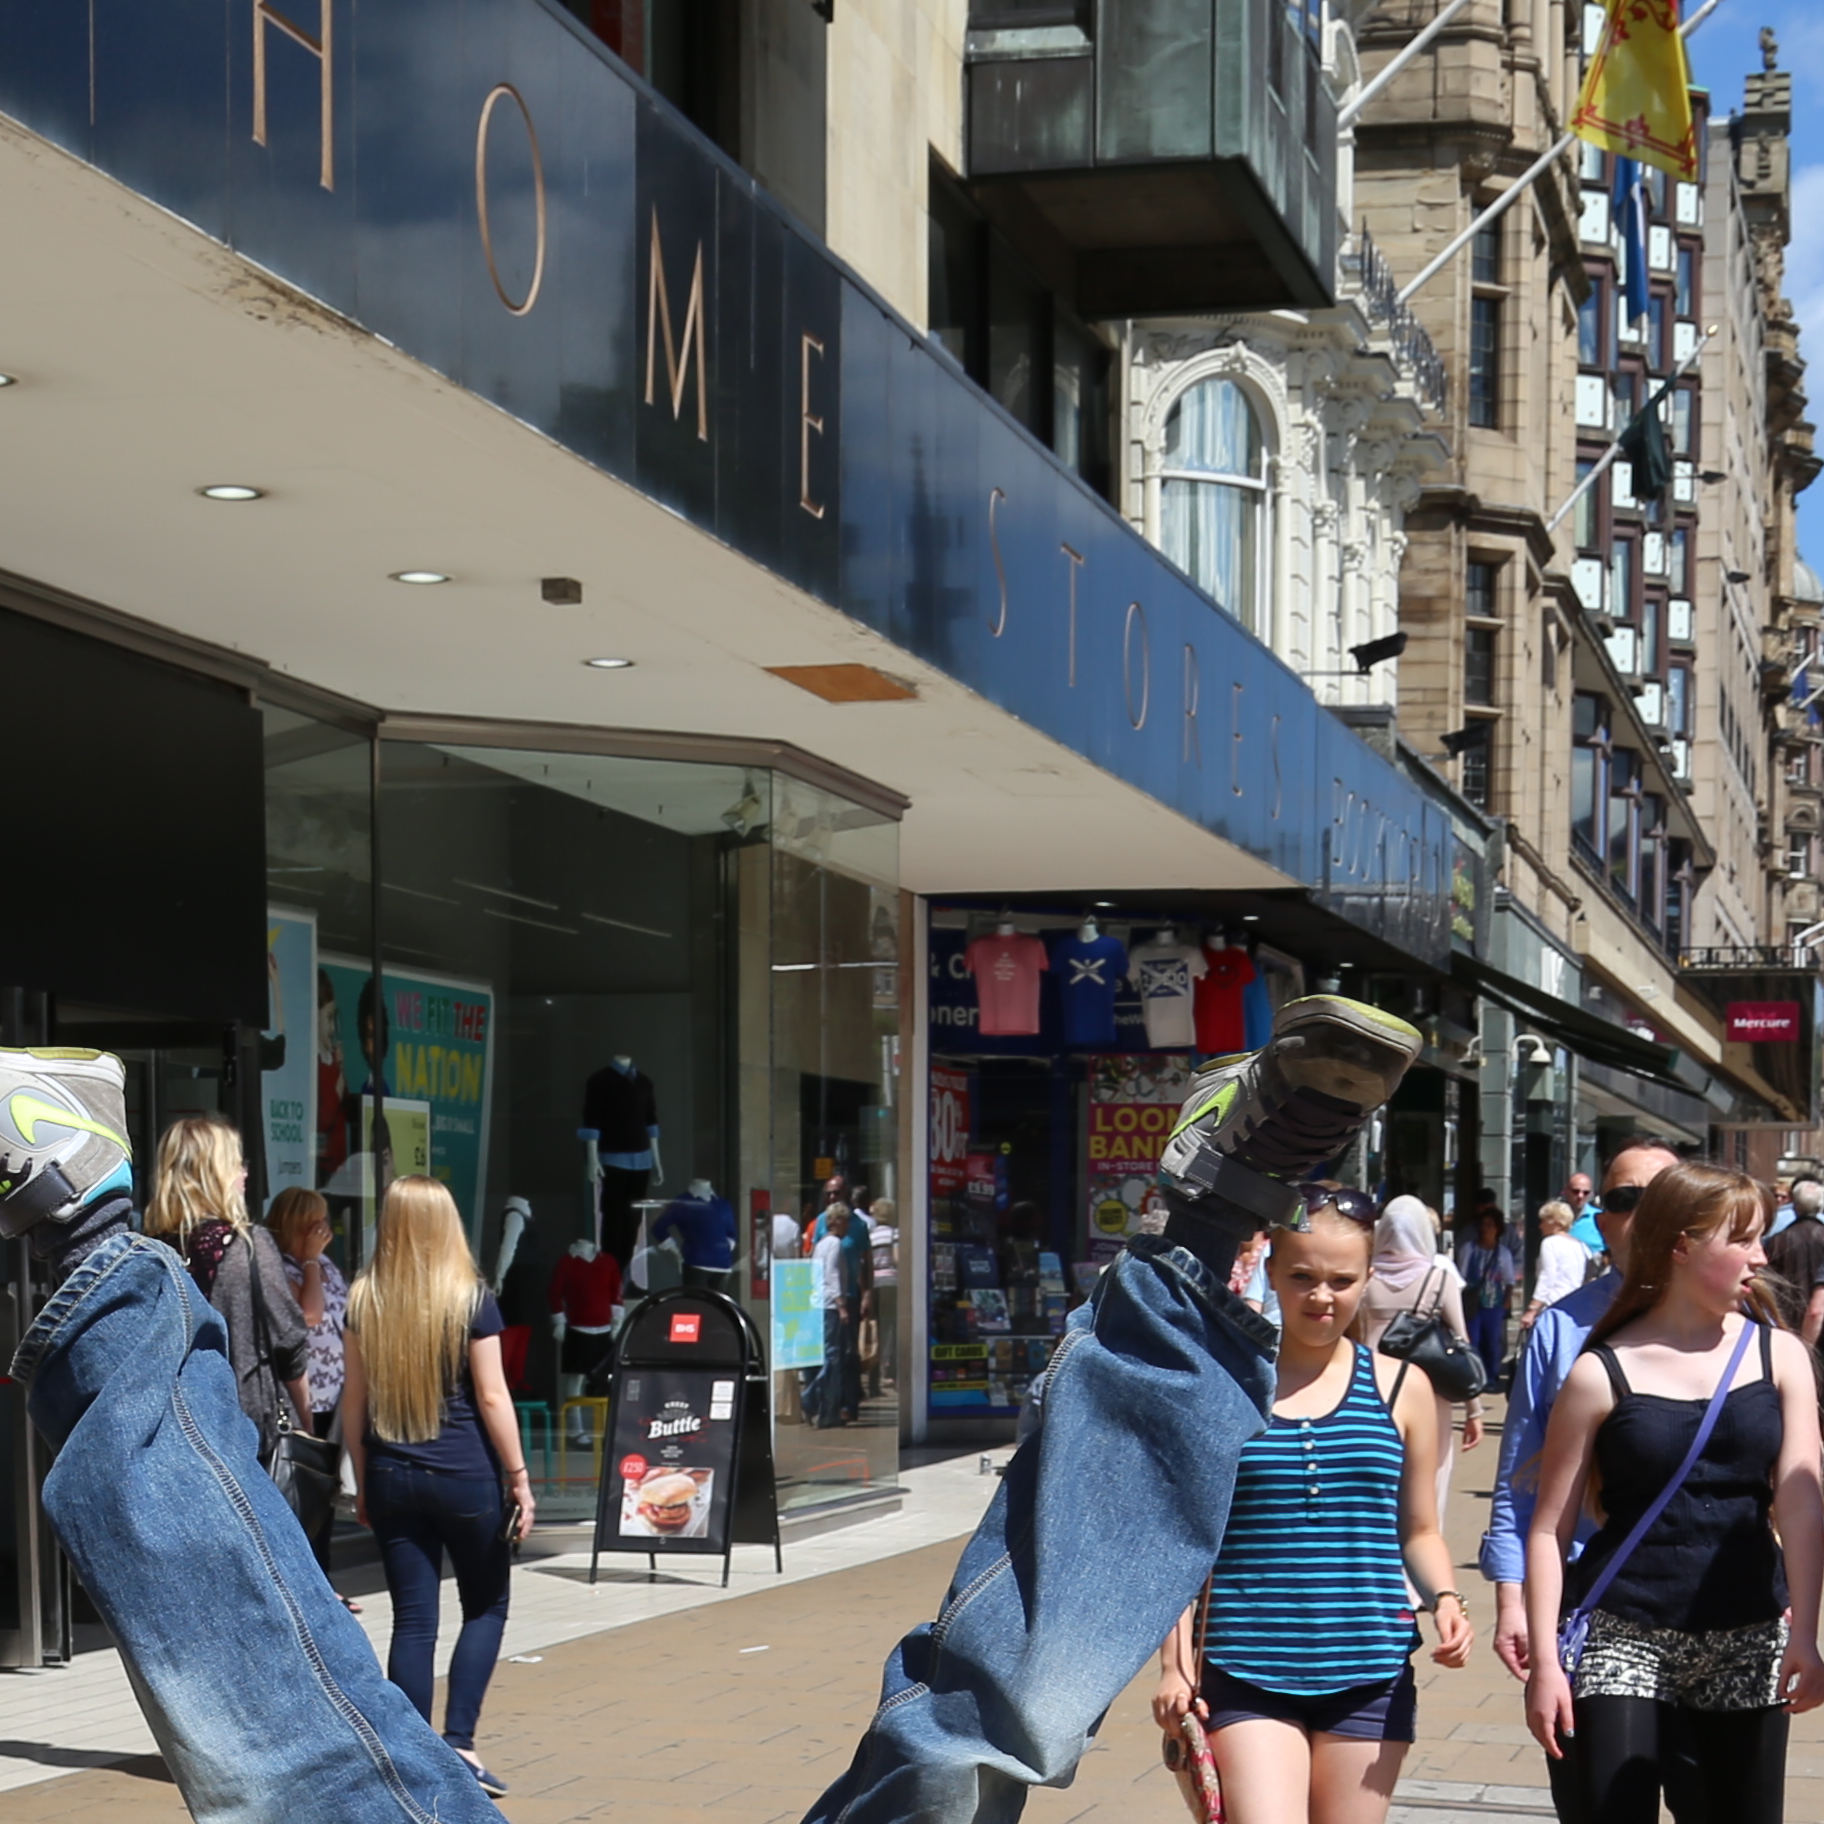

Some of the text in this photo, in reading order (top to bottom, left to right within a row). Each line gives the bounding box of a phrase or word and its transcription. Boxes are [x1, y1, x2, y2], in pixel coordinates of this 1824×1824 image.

[252, 0, 1283, 820] HOME STORES
[395, 991, 485, 1041] WE FIT THE
[1733, 1017, 1791, 1028] Mercure
[395, 1041, 483, 1105] NATION
[270, 1122, 305, 1143] SCHOOL
[674, 1322, 695, 1334] BHS
